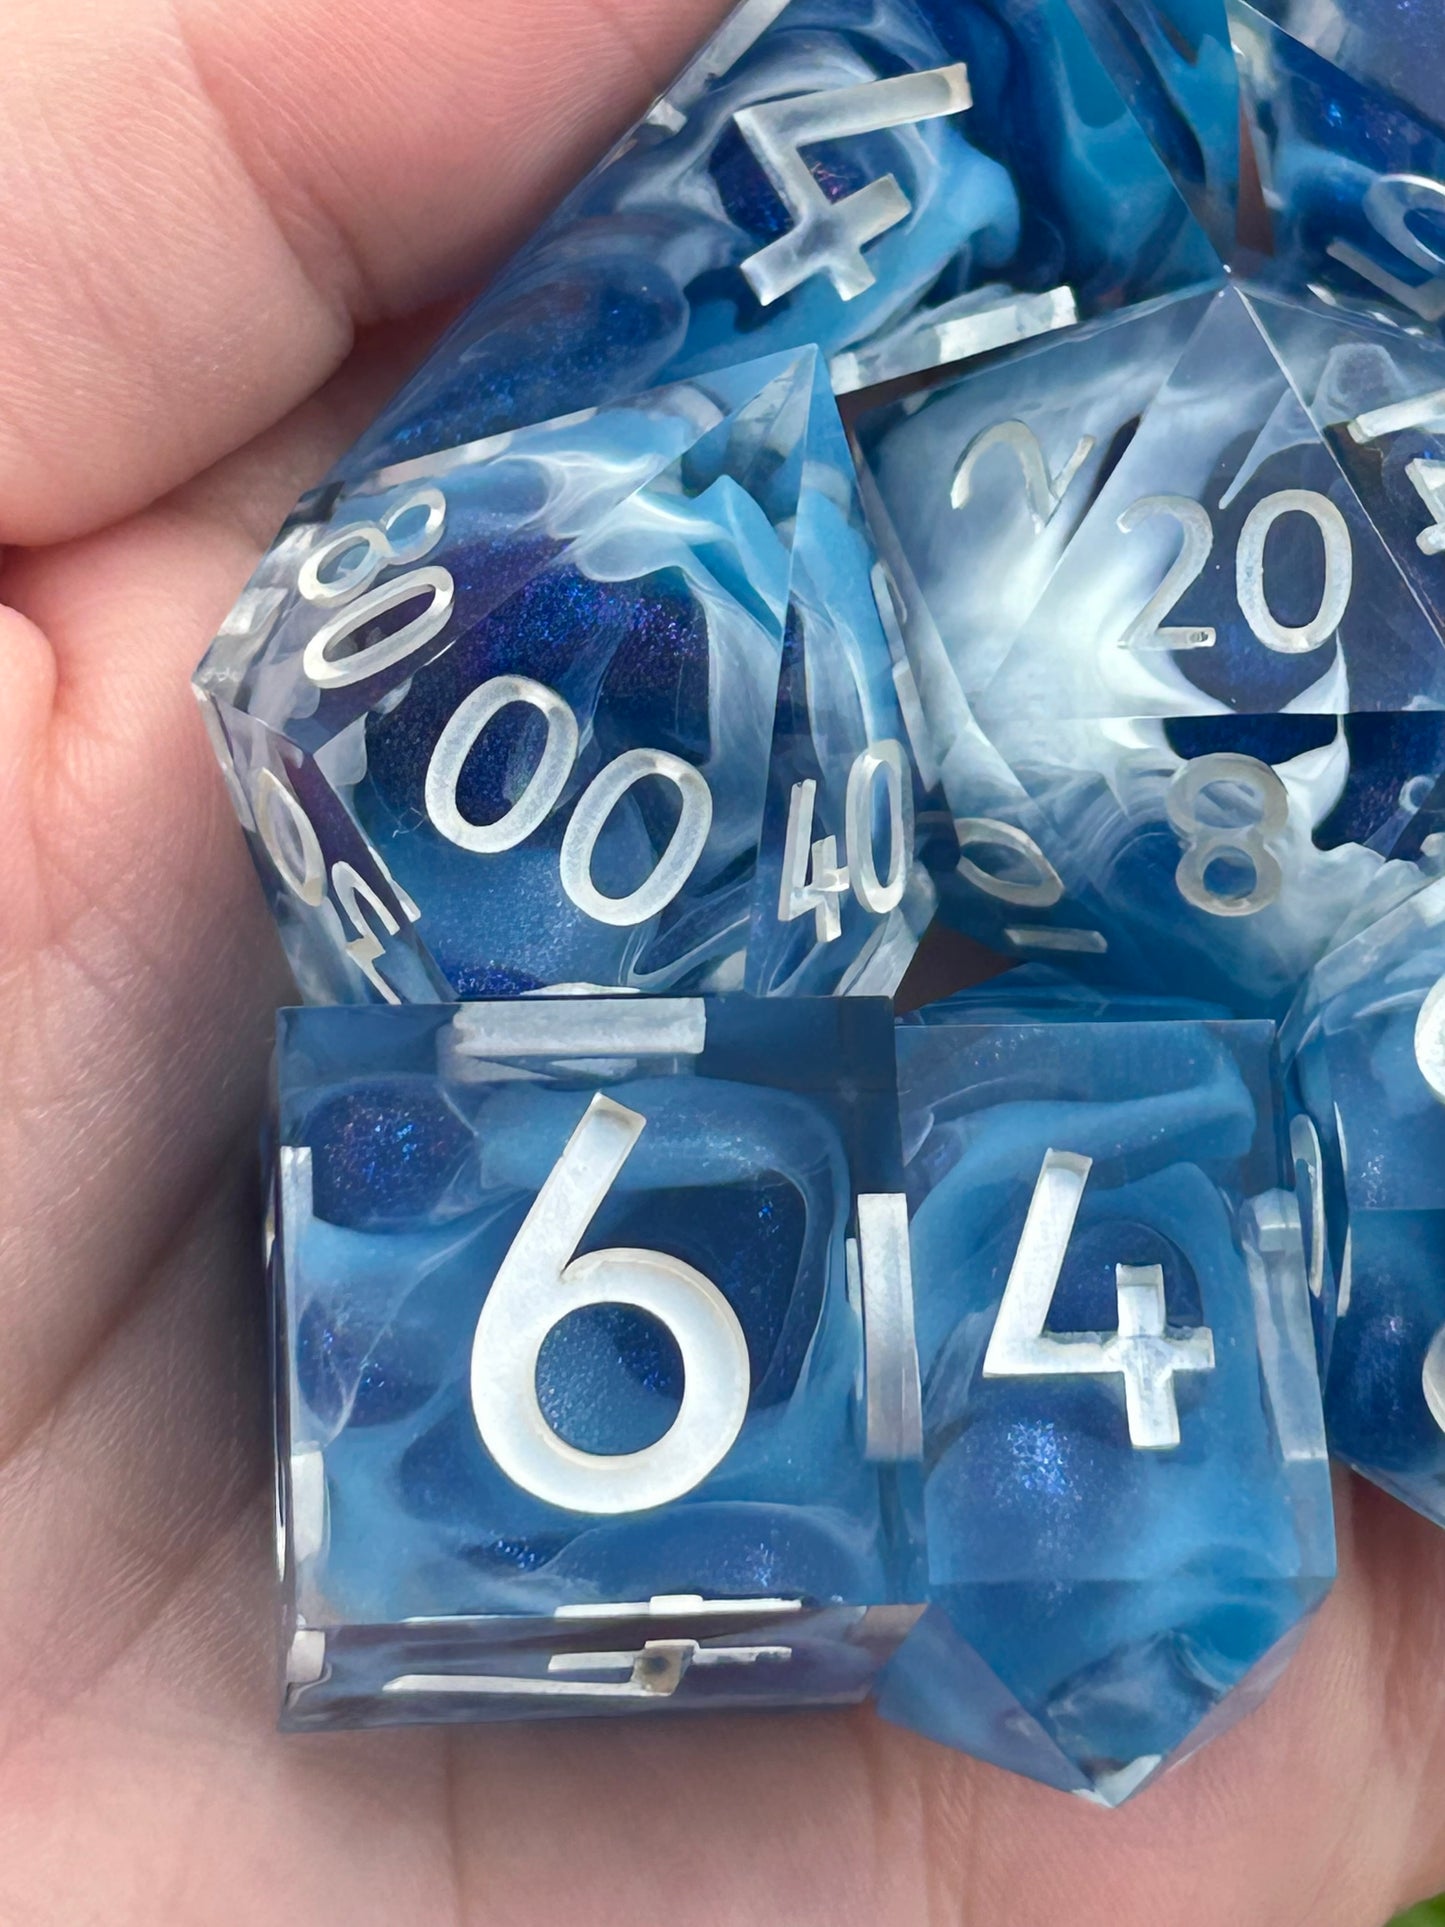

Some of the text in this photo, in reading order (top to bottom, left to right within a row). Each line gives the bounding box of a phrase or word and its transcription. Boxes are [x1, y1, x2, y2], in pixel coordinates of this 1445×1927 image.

[734, 62, 973, 306] 4
[1117, 488, 1353, 654] 20
[425, 674, 713, 927] 00
[778, 738, 914, 942] 40
[1165, 752, 1289, 917] 8
[471, 1092, 751, 1514] 6
[983, 1148, 1215, 1450] 4
